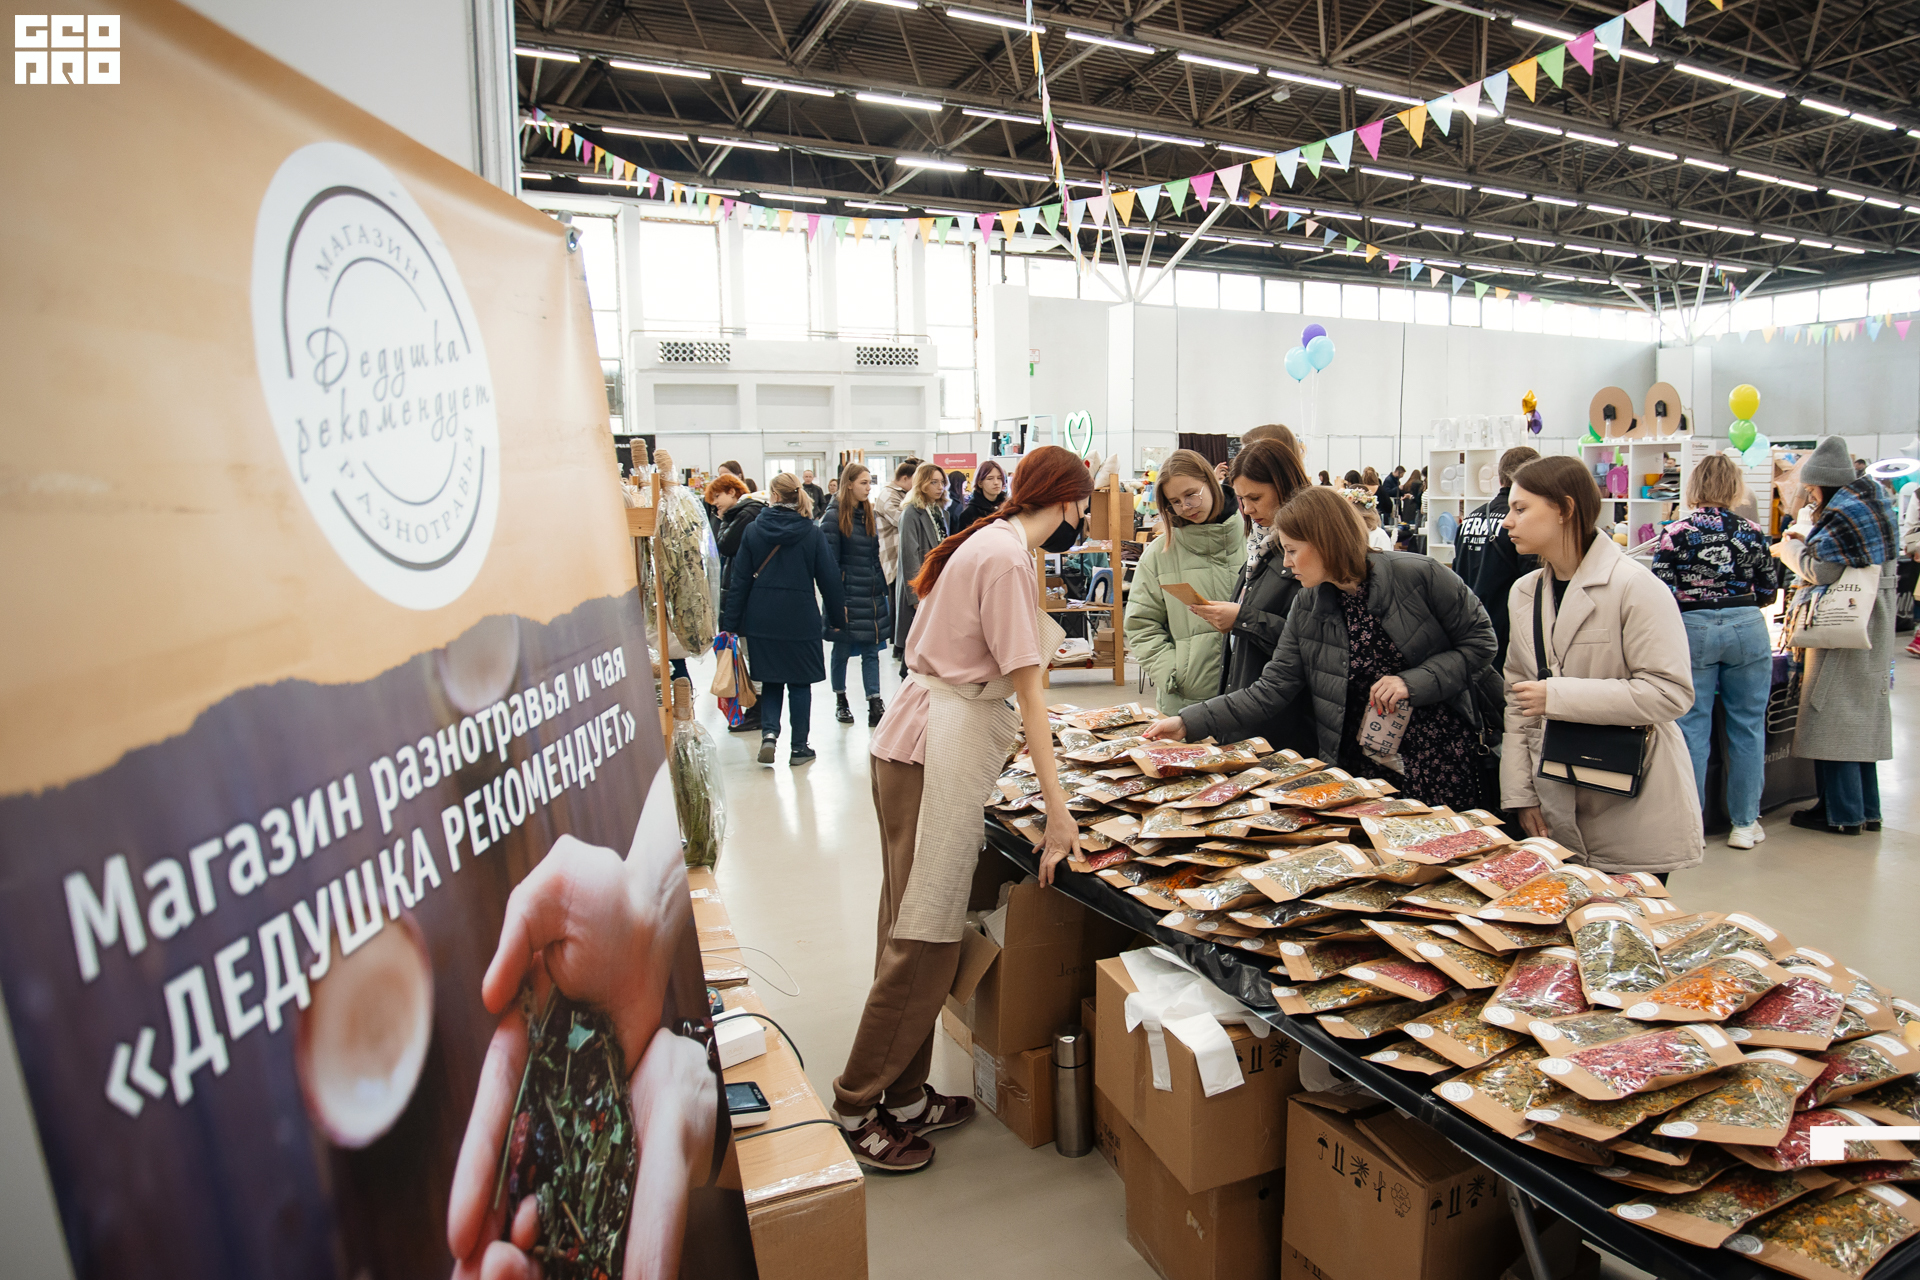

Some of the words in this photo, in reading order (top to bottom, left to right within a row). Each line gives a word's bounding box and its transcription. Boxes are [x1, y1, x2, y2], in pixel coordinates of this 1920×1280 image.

[314, 224, 421, 283] МАГАЗИН
[305, 319, 461, 402] Дедушка
[296, 382, 491, 484] рекомендует
[338, 425, 476, 545] РАЗНОТРАВЬЯ
[63, 771, 364, 984] Магазин
[368, 670, 572, 834] разнотравья
[572, 662, 591, 703] и
[591, 646, 627, 690] чая
[105, 826, 442, 1118] «ДЕДУШКА
[440, 709, 636, 873] РЕКОМЕНДУЕТ»
[859, 1132, 890, 1156] N
[924, 1104, 947, 1124] N
